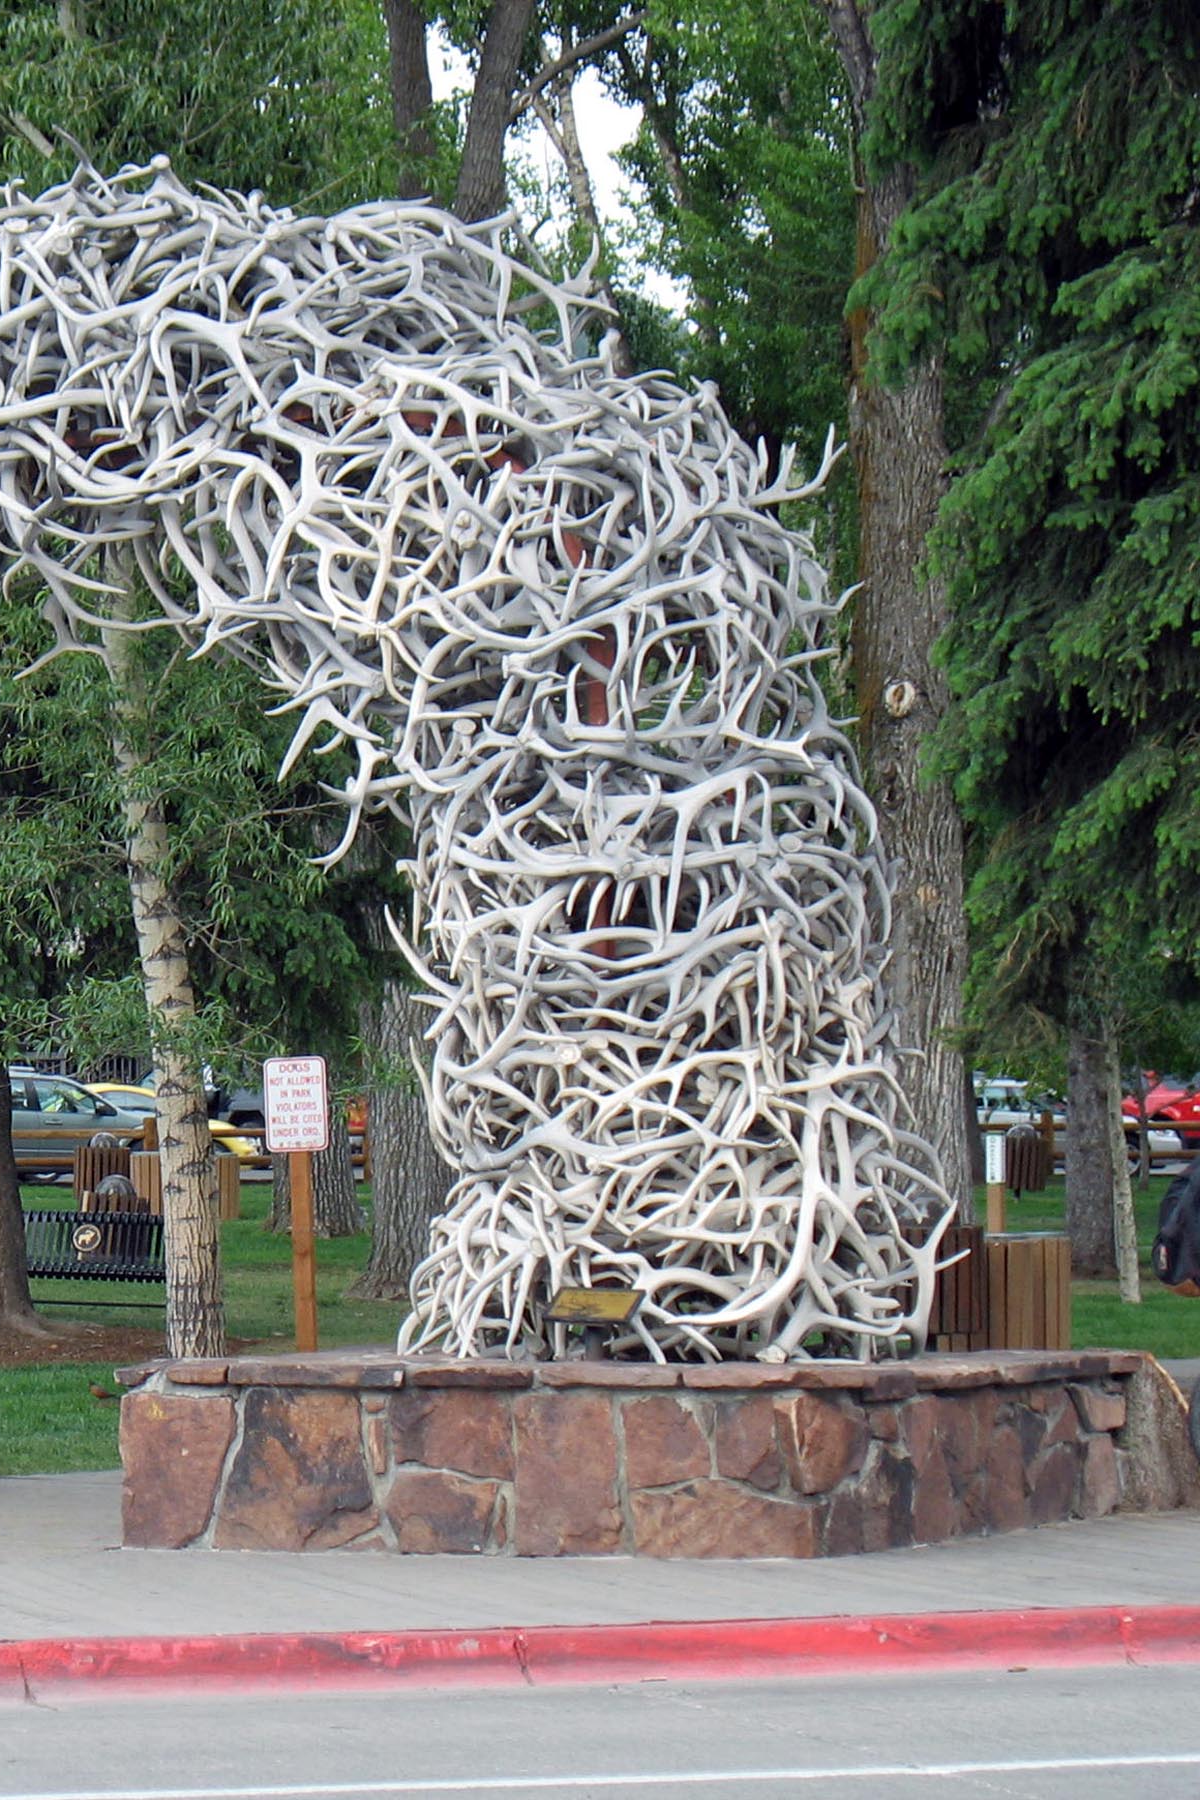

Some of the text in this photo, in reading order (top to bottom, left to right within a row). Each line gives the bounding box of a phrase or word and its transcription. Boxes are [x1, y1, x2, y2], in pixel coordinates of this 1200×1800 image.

[279, 1063, 310, 1073] DOGS
[270, 1075, 320, 1086] NOT ALLOWED
[280, 1089, 312, 1098] IN PARK
[276, 1102, 317, 1112] VIOLATORS
[272, 1116, 287, 1124] WILL
[303, 1114, 321, 1123] CITED
[273, 1128, 298, 1137] UNDER
